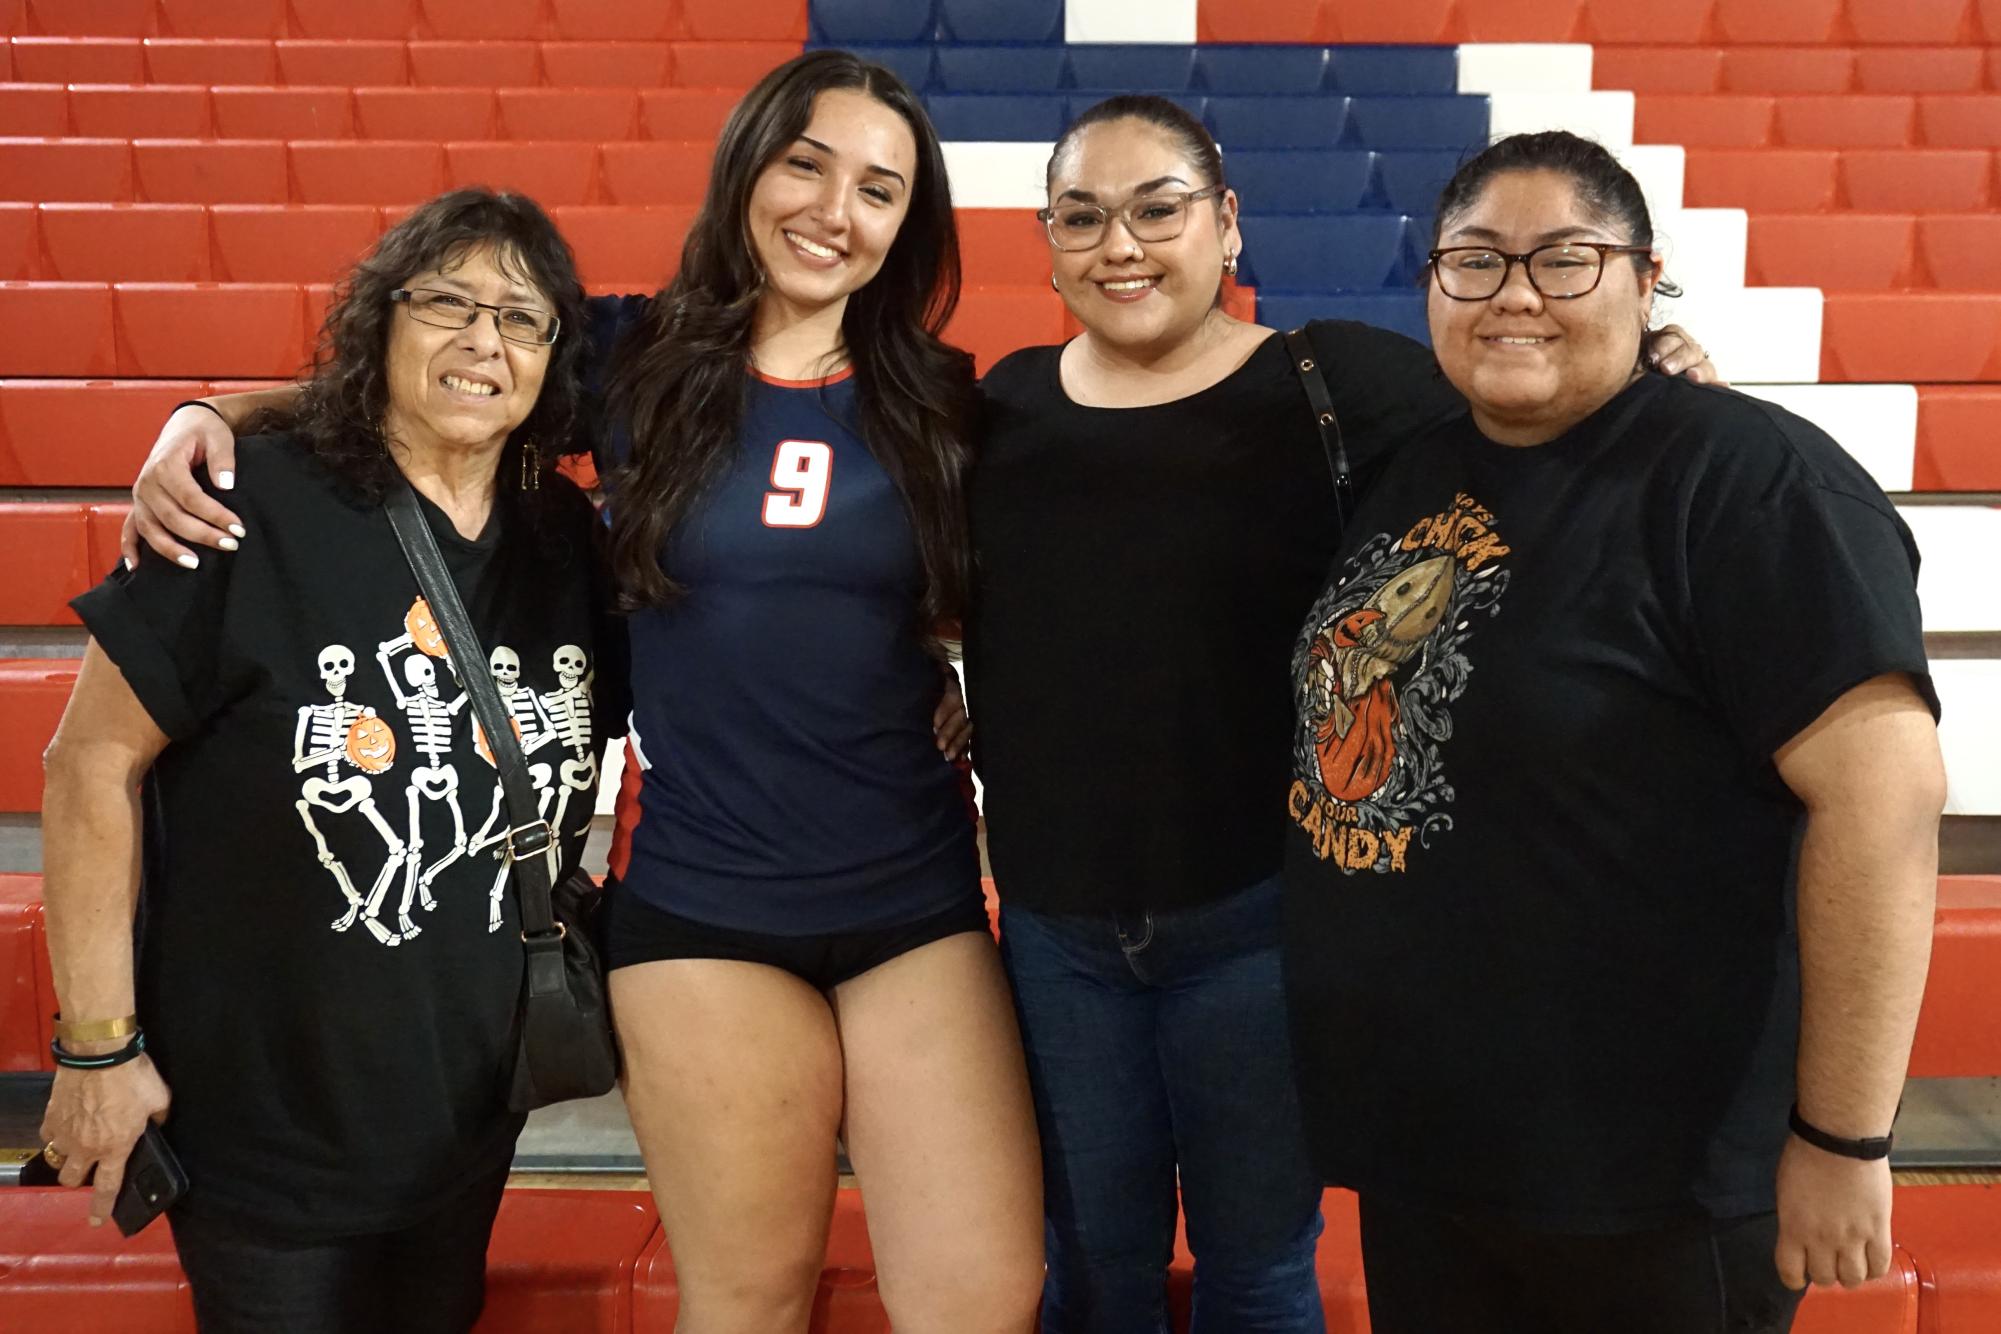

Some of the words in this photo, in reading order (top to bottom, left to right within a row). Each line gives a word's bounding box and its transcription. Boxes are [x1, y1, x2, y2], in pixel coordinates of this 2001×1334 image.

[760, 438, 834, 528] 9
[1288, 779, 1412, 873] CANDY
[1319, 792, 1359, 822] YOUR
